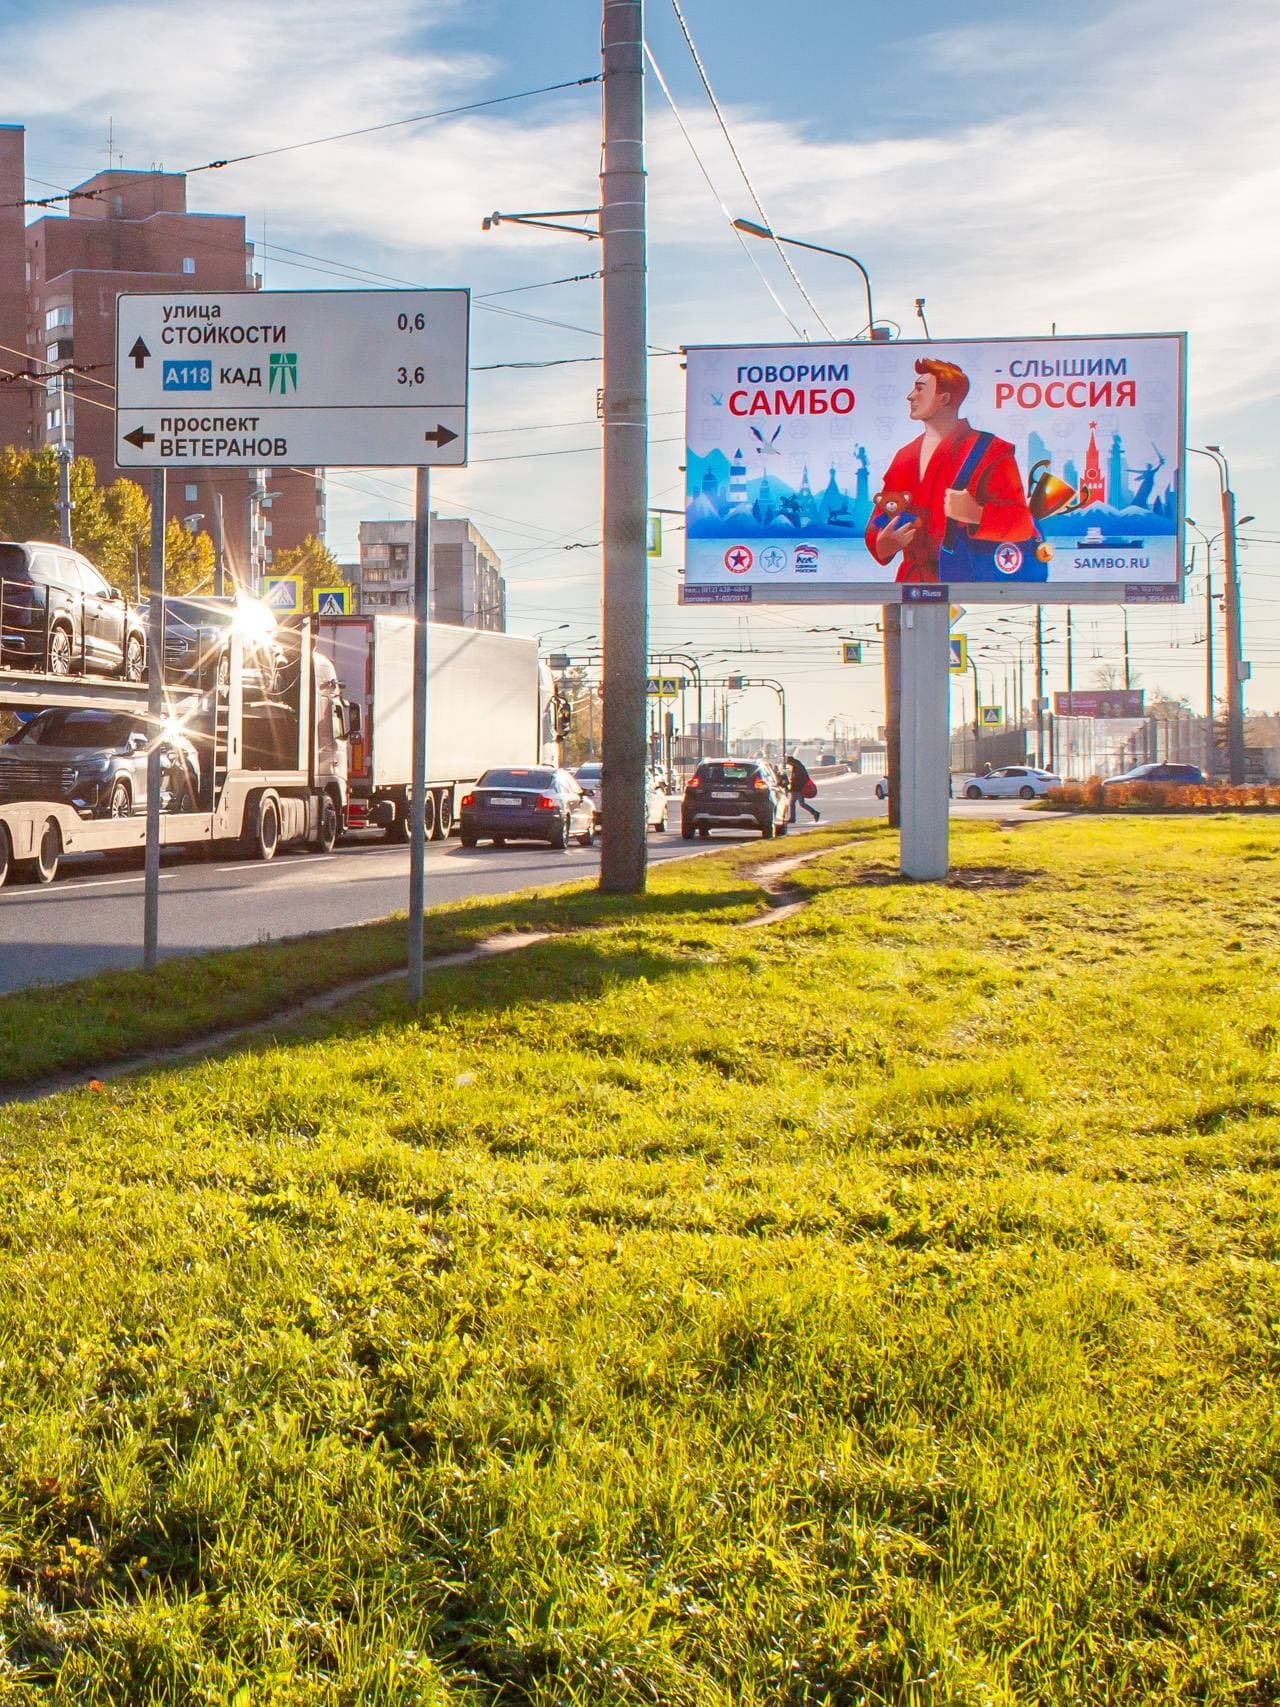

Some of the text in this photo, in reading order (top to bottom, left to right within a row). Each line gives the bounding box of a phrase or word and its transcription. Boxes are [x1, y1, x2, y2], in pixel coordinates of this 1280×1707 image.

[162, 304, 221, 323] улица
[161, 323, 286, 345] СТОЙКОСТИ
[396, 313, 426, 335] 0,6
[219, 367, 262, 387] КАД
[396, 366, 426, 389] 3,6
[736, 363, 850, 384] ГОВОРИМ
[1009, 358, 1128, 378] СЛЫШИМ
[729, 388, 856, 416] САМБО
[994, 380, 1137, 409] РОССИЯ
[160, 417, 261, 436] проспект
[160, 438, 288, 458] ВЕТЕРАНОВ
[1073, 558, 1150, 569] SAMBO.RU
